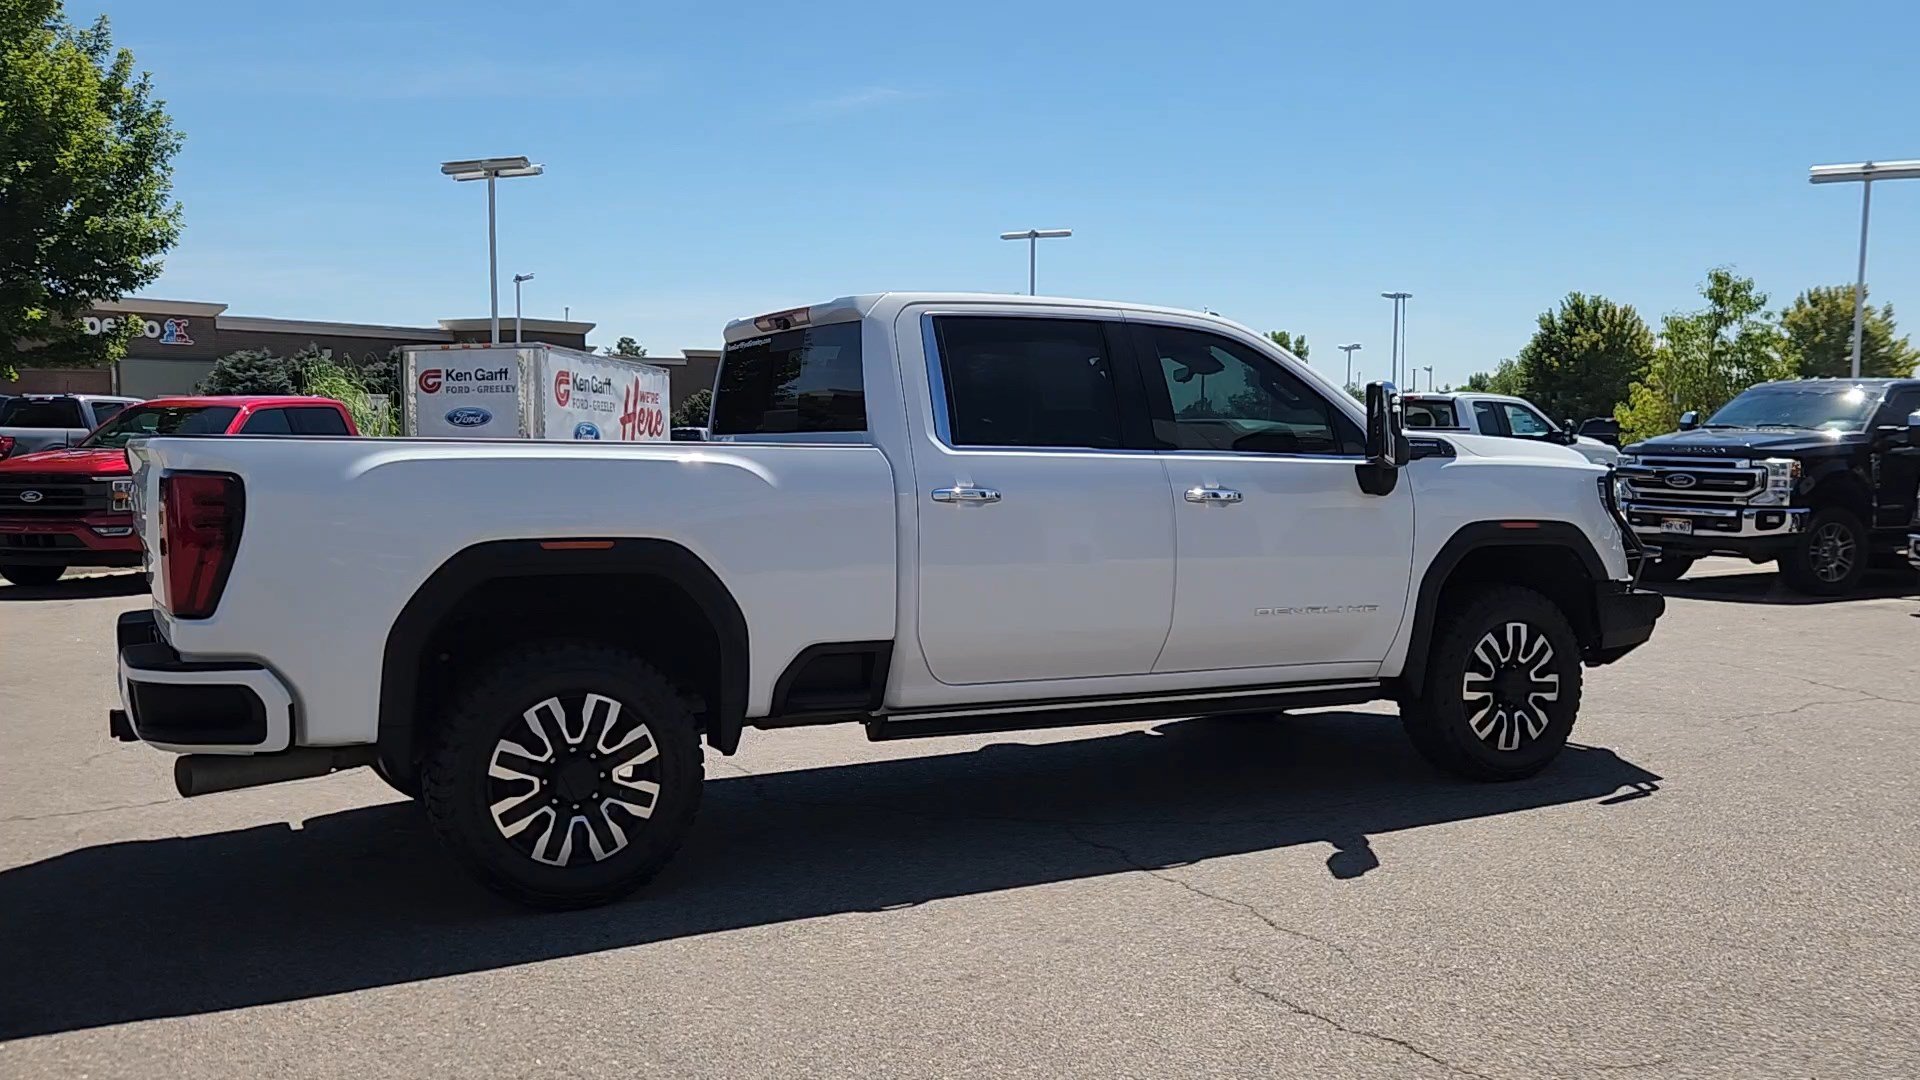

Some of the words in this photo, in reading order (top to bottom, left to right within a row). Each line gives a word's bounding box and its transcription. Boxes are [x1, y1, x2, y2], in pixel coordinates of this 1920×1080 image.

[445, 368, 472, 381] Ken
[474, 367, 509, 381] Garff
[445, 385, 470, 394] FORD
[477, 384, 517, 394] GREELEY
[572, 371, 590, 393] Ken
[591, 375, 612, 396] Garff
[572, 397, 589, 411] FORD
[593, 400, 616, 413] GREELEY
[619, 375, 665, 440] Here
[454, 410, 483, 424] Ford
